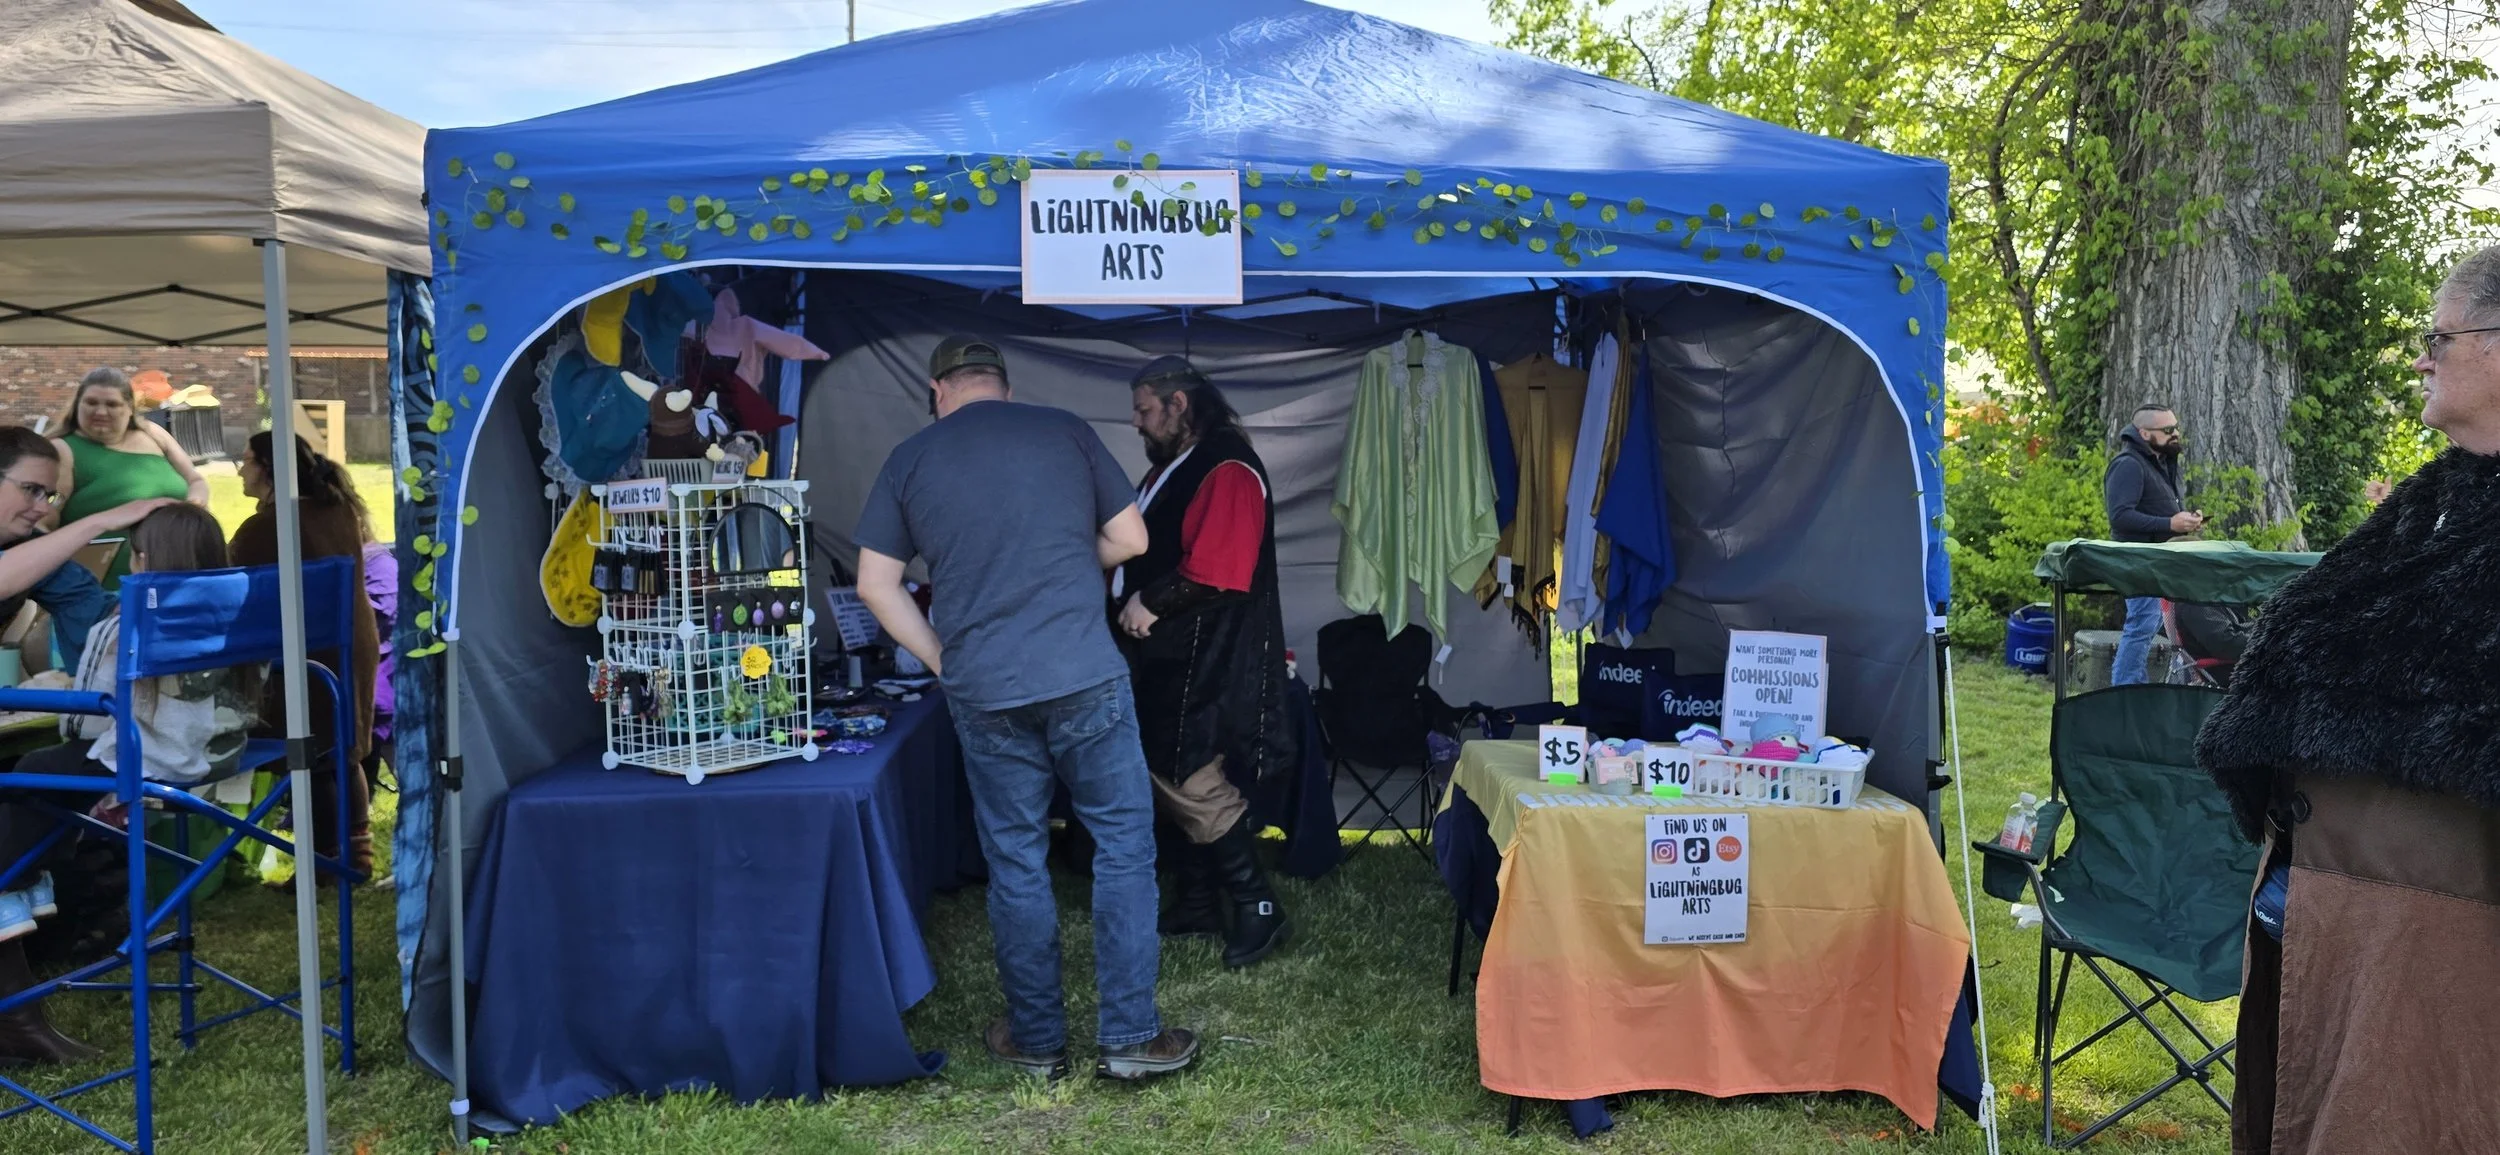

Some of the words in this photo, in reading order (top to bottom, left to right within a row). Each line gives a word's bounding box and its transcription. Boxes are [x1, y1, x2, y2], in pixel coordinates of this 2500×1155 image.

[1101, 242, 1164, 281] ARTS
[611, 489, 640, 506] JEWELRY
[642, 487, 661, 505] $10
[1735, 645, 1755, 655] WANT
[1799, 649, 1818, 658] MORE
[1731, 666, 1820, 689] COMMISSIONS
[1755, 686, 1794, 705] OPEN!
[1732, 708, 1747, 718] TAKE
[1748, 710, 1754, 718] A
[1800, 714, 1814, 722] AND
[1544, 737, 1581, 767] $5
[1648, 758, 1691, 785] $10
[1693, 818, 1708, 834] US
[1712, 816, 1728, 832] ON
[1718, 843, 1740, 855] Etsy
[1691, 866, 1701, 877] AS
[1681, 897, 1712, 916] ARTS
